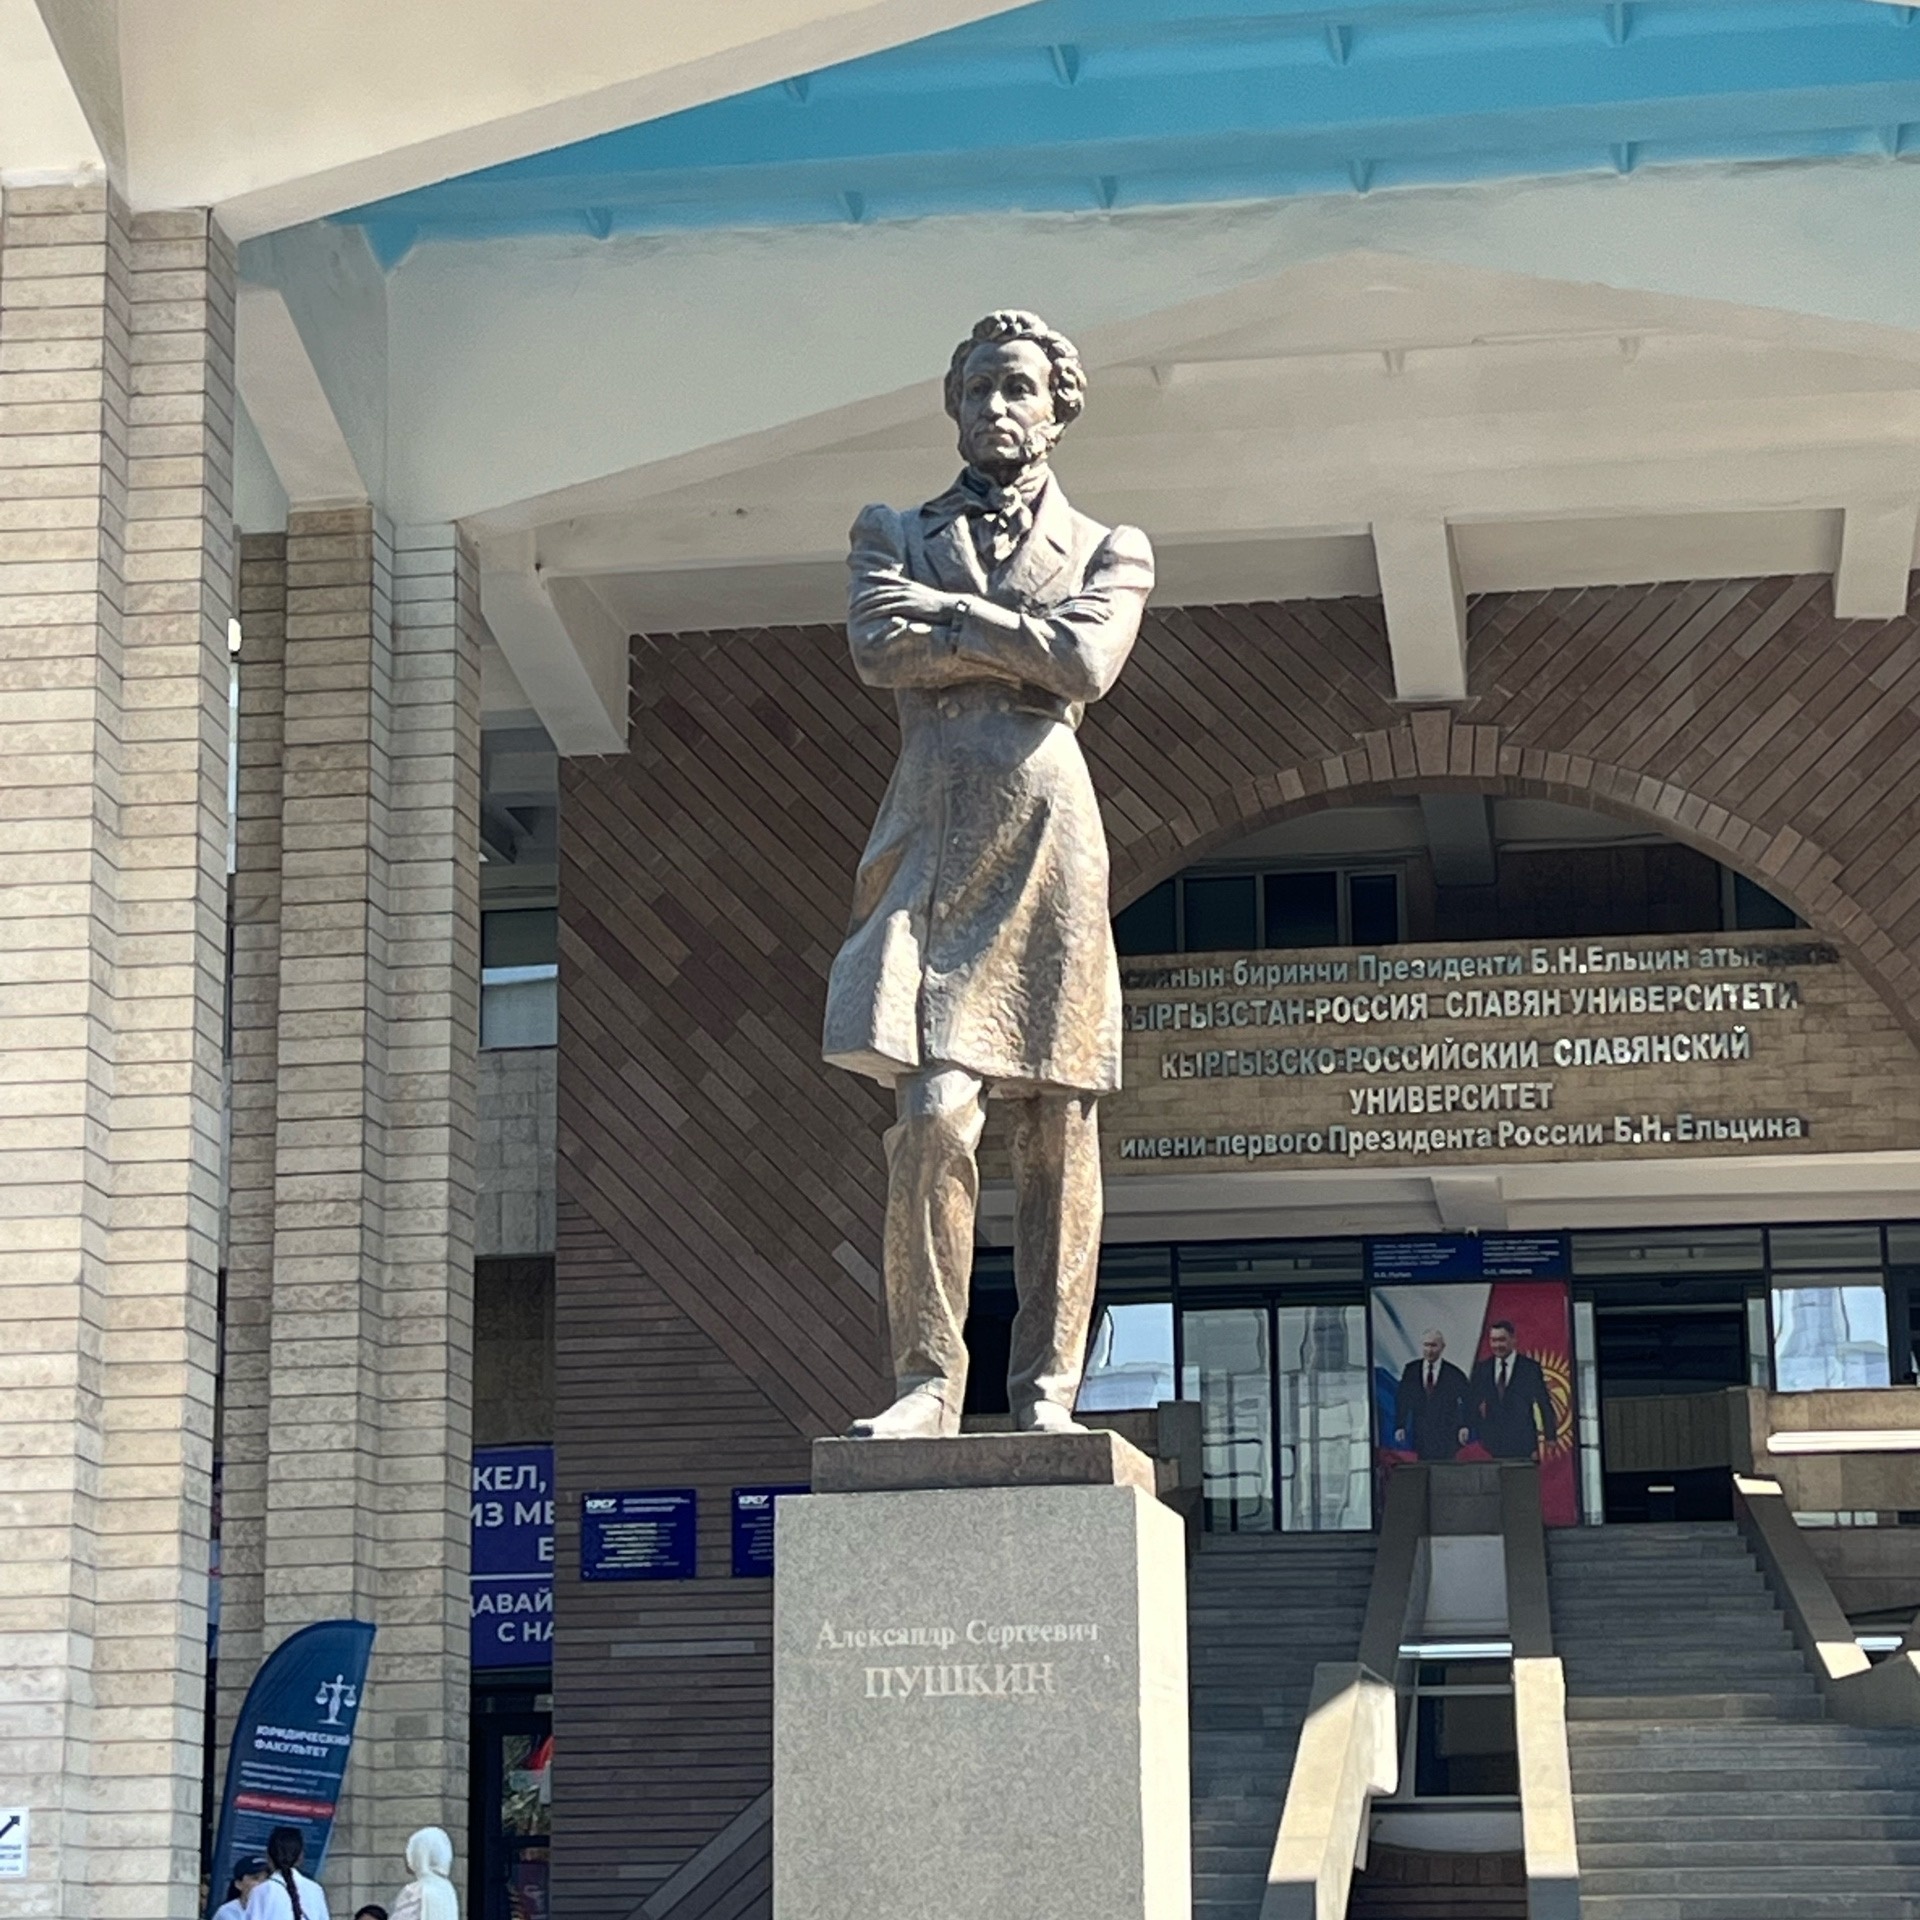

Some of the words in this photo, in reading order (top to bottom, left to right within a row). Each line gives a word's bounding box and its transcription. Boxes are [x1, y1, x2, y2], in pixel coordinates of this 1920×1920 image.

[1233, 959, 1348, 988] биринчи
[1358, 953, 1522, 987] Президенти
[1446, 987, 1561, 1019] СЛАВЯН
[1570, 981, 1799, 1015] УНИВЕРСИТЕТИ
[1553, 1025, 1751, 1067] СЛАВЯНСКИЙ
[1350, 1082, 1553, 1115] УНИВЕРСИТЕТ
[1120, 1137, 1207, 1159] имени
[1215, 1130, 1323, 1160] первого
[1329, 1124, 1492, 1158] Президента
[1499, 1119, 1603, 1148] России
[1676, 1112, 1802, 1144] Ельцина
[473, 1465, 547, 1494] КЕЛ,
[497, 1621, 516, 1642] С
[816, 1620, 957, 1650] Александр
[966, 1620, 1101, 1650] Сергеевич
[864, 1662, 1055, 1699] ПУШКИН
